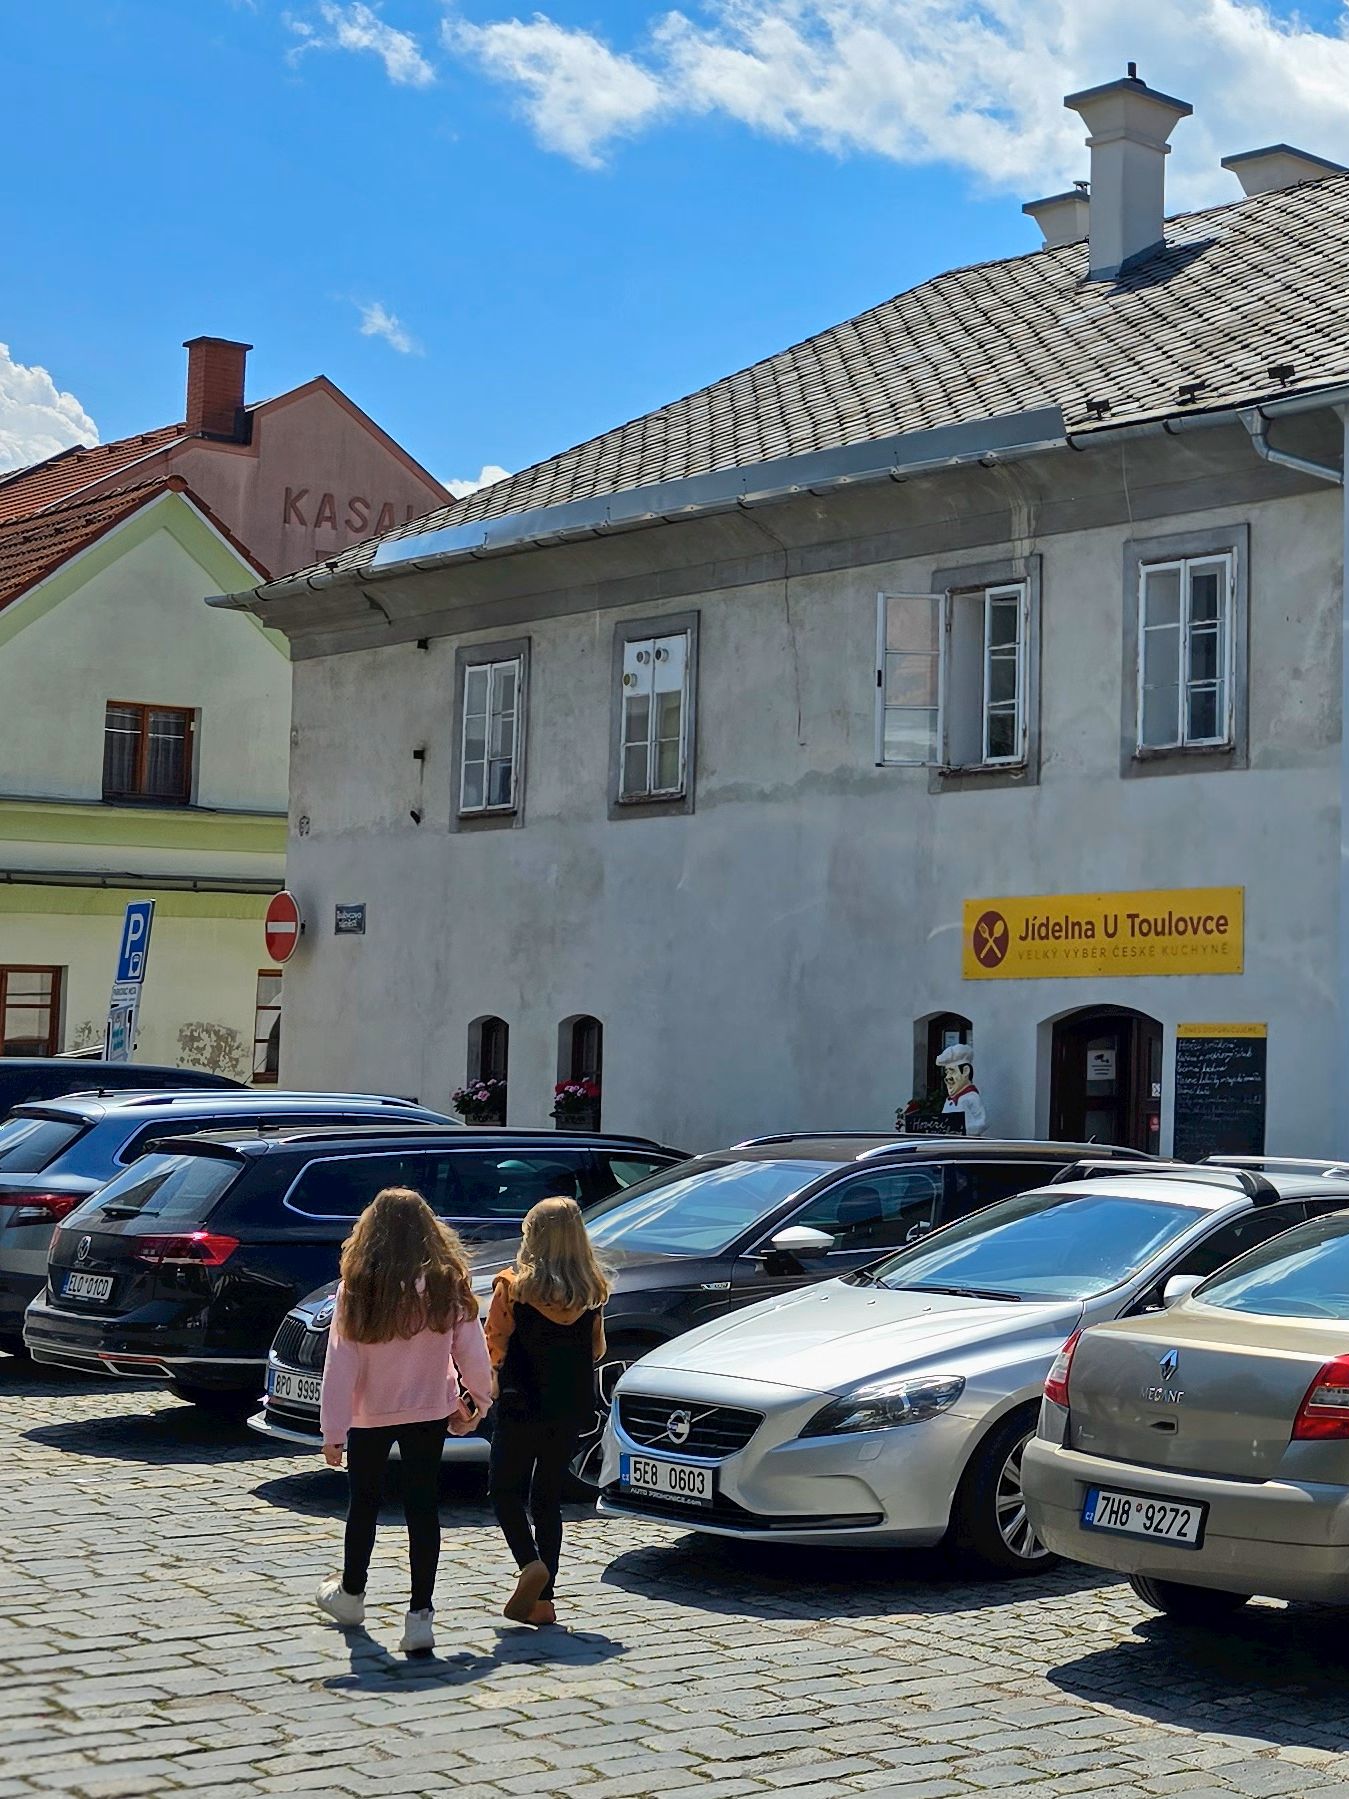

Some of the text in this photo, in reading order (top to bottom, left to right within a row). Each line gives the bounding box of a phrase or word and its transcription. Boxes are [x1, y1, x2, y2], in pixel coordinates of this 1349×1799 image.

[125, 913, 145, 959] P
[1018, 911, 1229, 941] Jídelna U Toulovce
[633, 1460, 705, 1495] 5E8 0603
[1097, 1496, 1192, 1538] 7H8 9272
